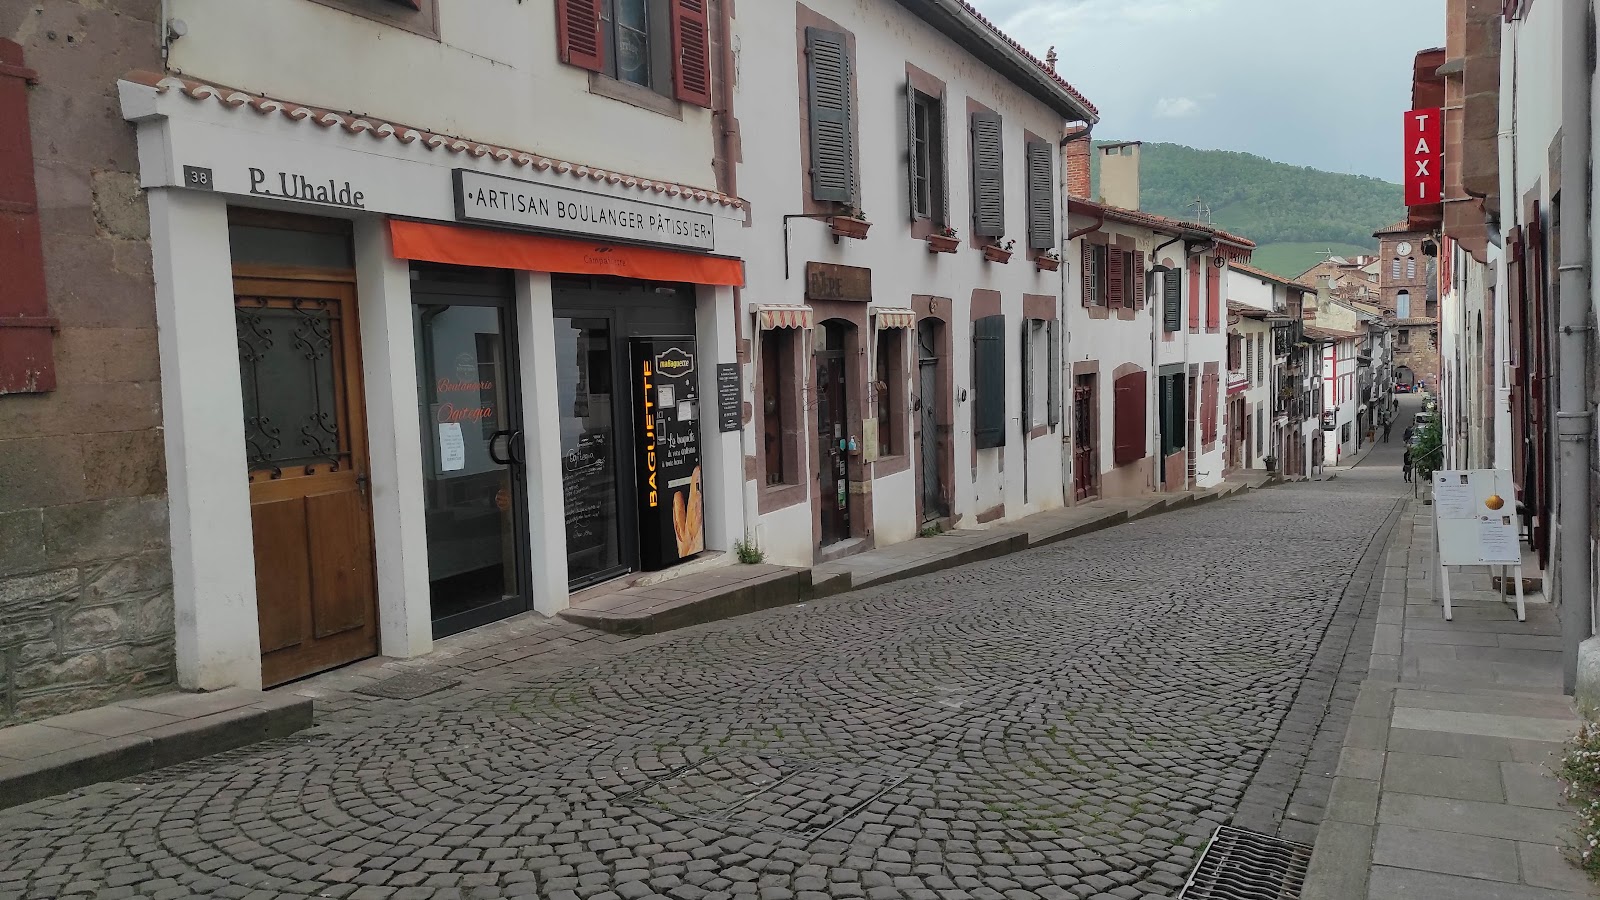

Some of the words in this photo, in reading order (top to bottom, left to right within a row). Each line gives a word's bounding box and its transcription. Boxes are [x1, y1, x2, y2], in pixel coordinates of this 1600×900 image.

[1414, 114, 1430, 198] TAXI
[190, 170, 208, 185] 38
[248, 167, 270, 194] P.
[278, 171, 365, 208] Uhalde
[557, 201, 644, 230] BOULANGER
[643, 359, 658, 508] BAGUETTE
